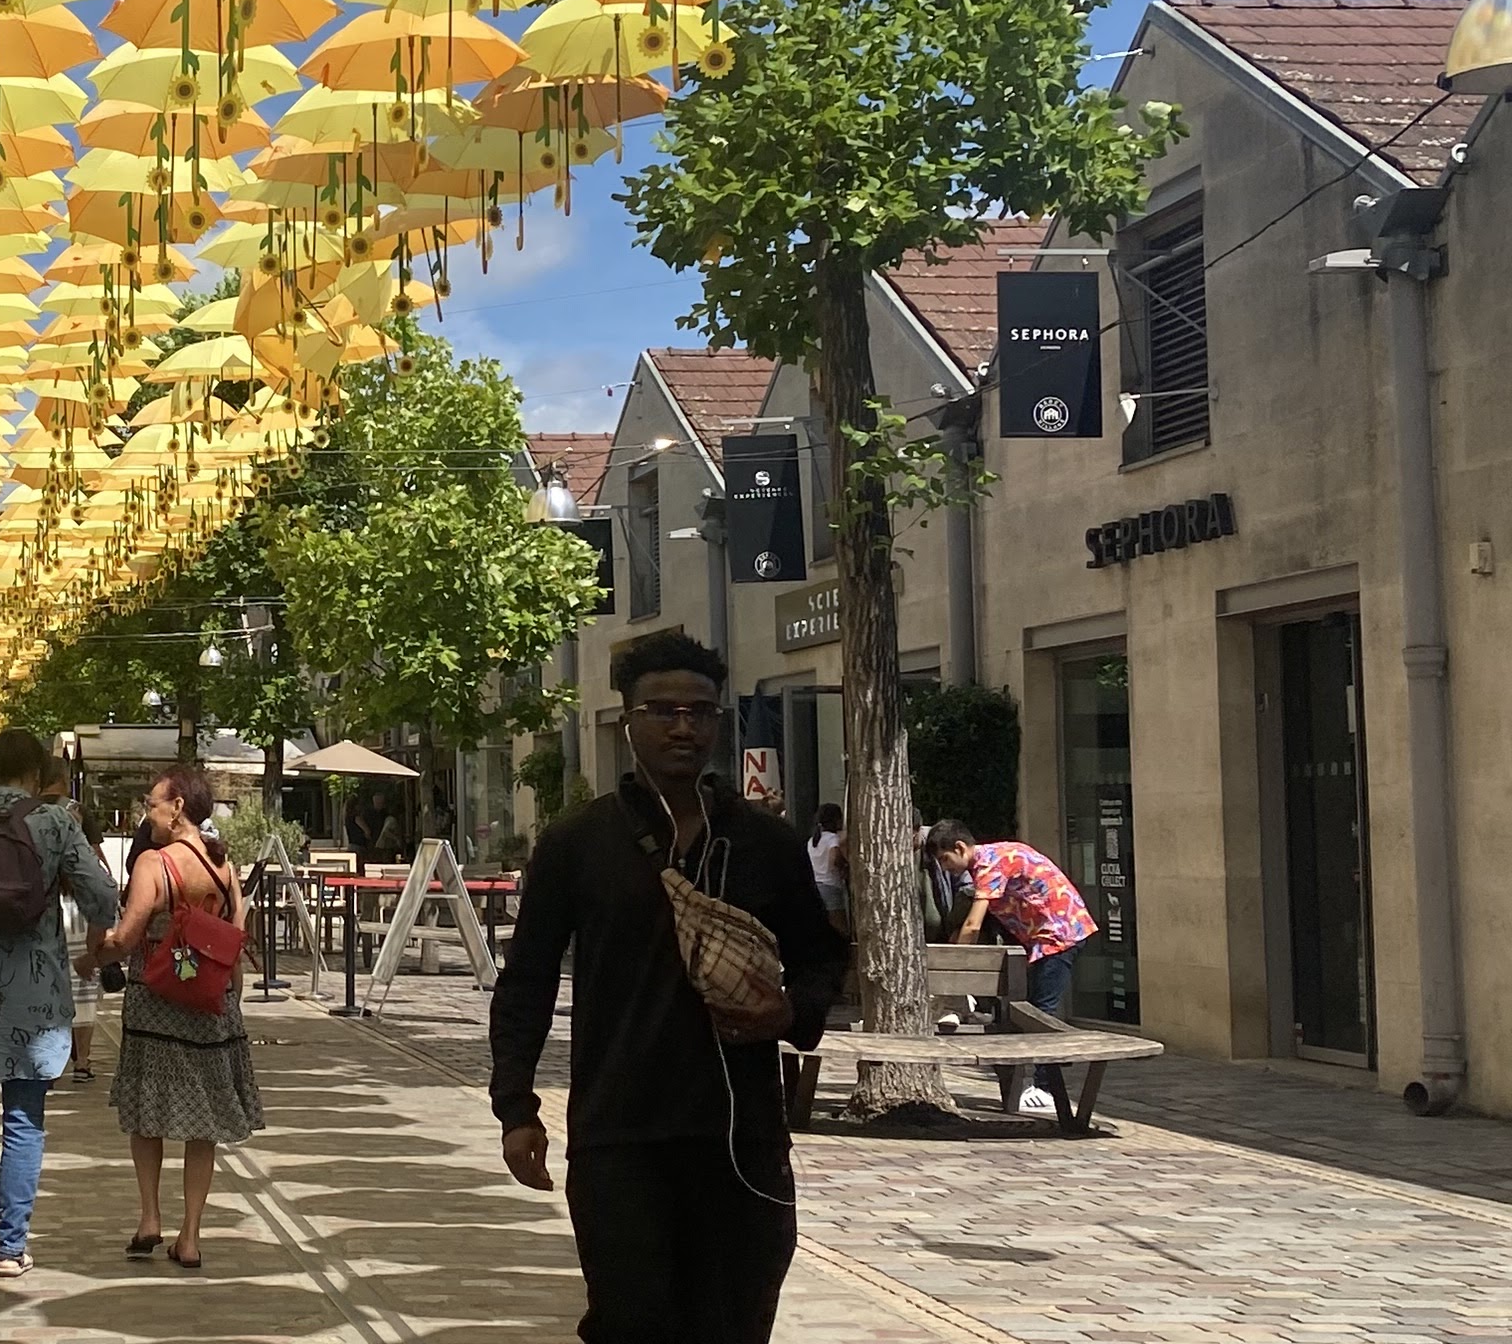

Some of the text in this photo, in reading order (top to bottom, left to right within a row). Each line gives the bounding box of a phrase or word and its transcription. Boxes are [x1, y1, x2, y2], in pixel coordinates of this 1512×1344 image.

[1010, 328, 1090, 341] SEPHORA
[1085, 492, 1236, 569] SEPHORA
[808, 587, 840, 613] SCIE
[785, 611, 840, 641] EXPERIE
